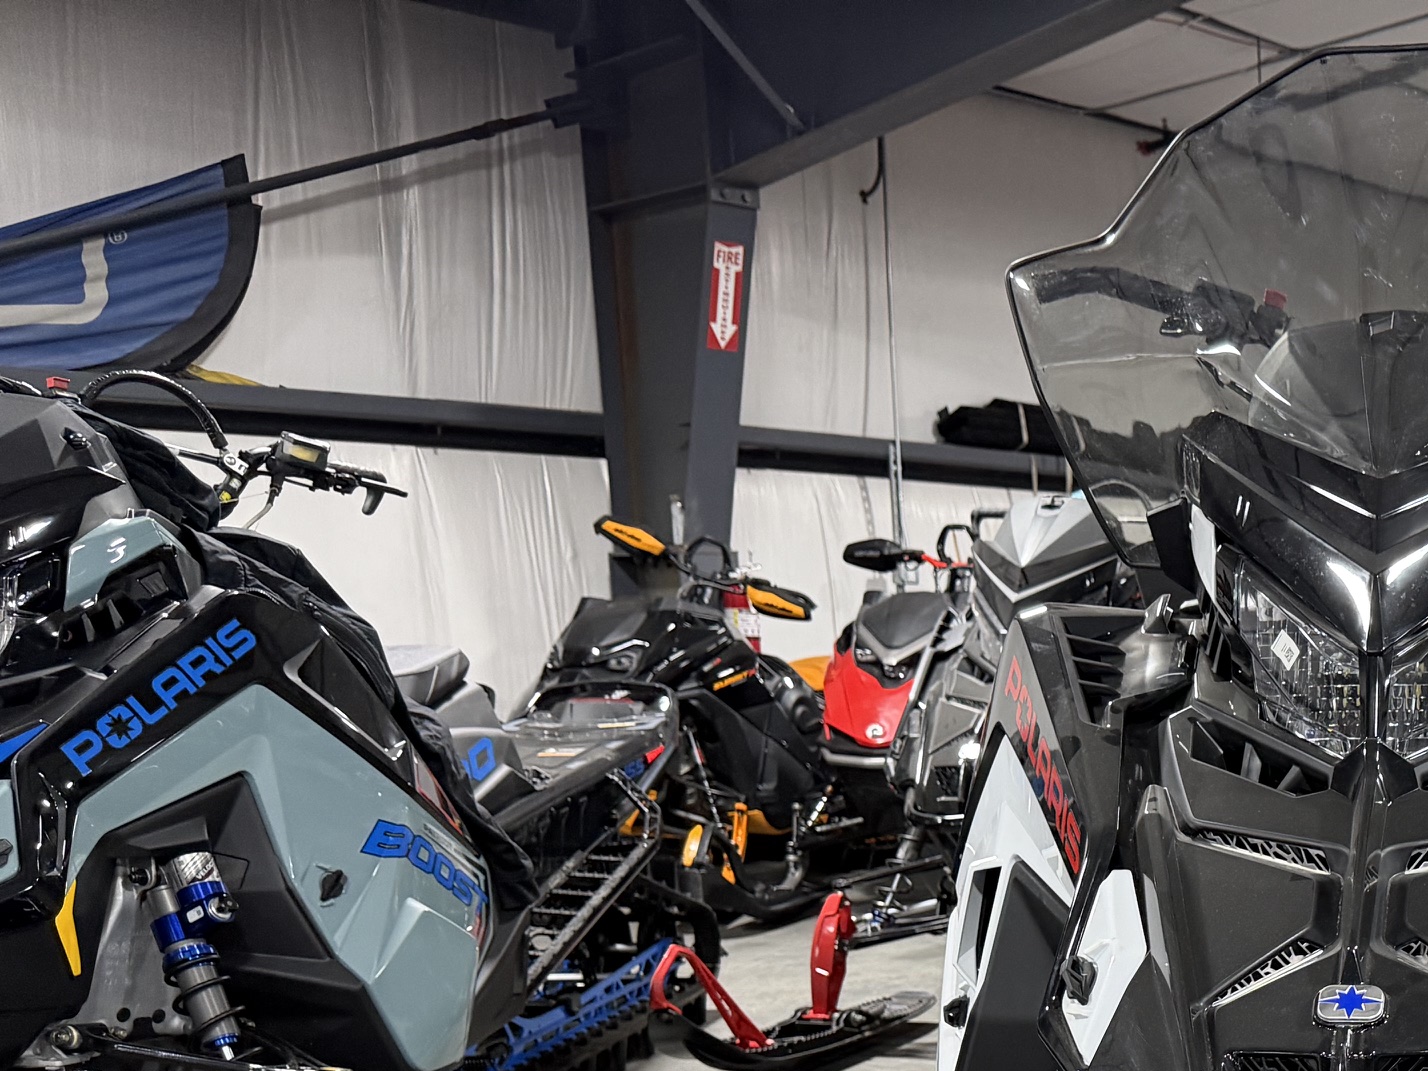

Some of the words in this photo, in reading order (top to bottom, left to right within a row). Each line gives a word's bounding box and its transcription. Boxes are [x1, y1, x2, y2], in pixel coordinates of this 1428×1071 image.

[716, 249, 741, 267] FIRE
[59, 618, 257, 776] POLARIS
[1005, 655, 1081, 874] POLARIS
[360, 819, 489, 917] BOOST
